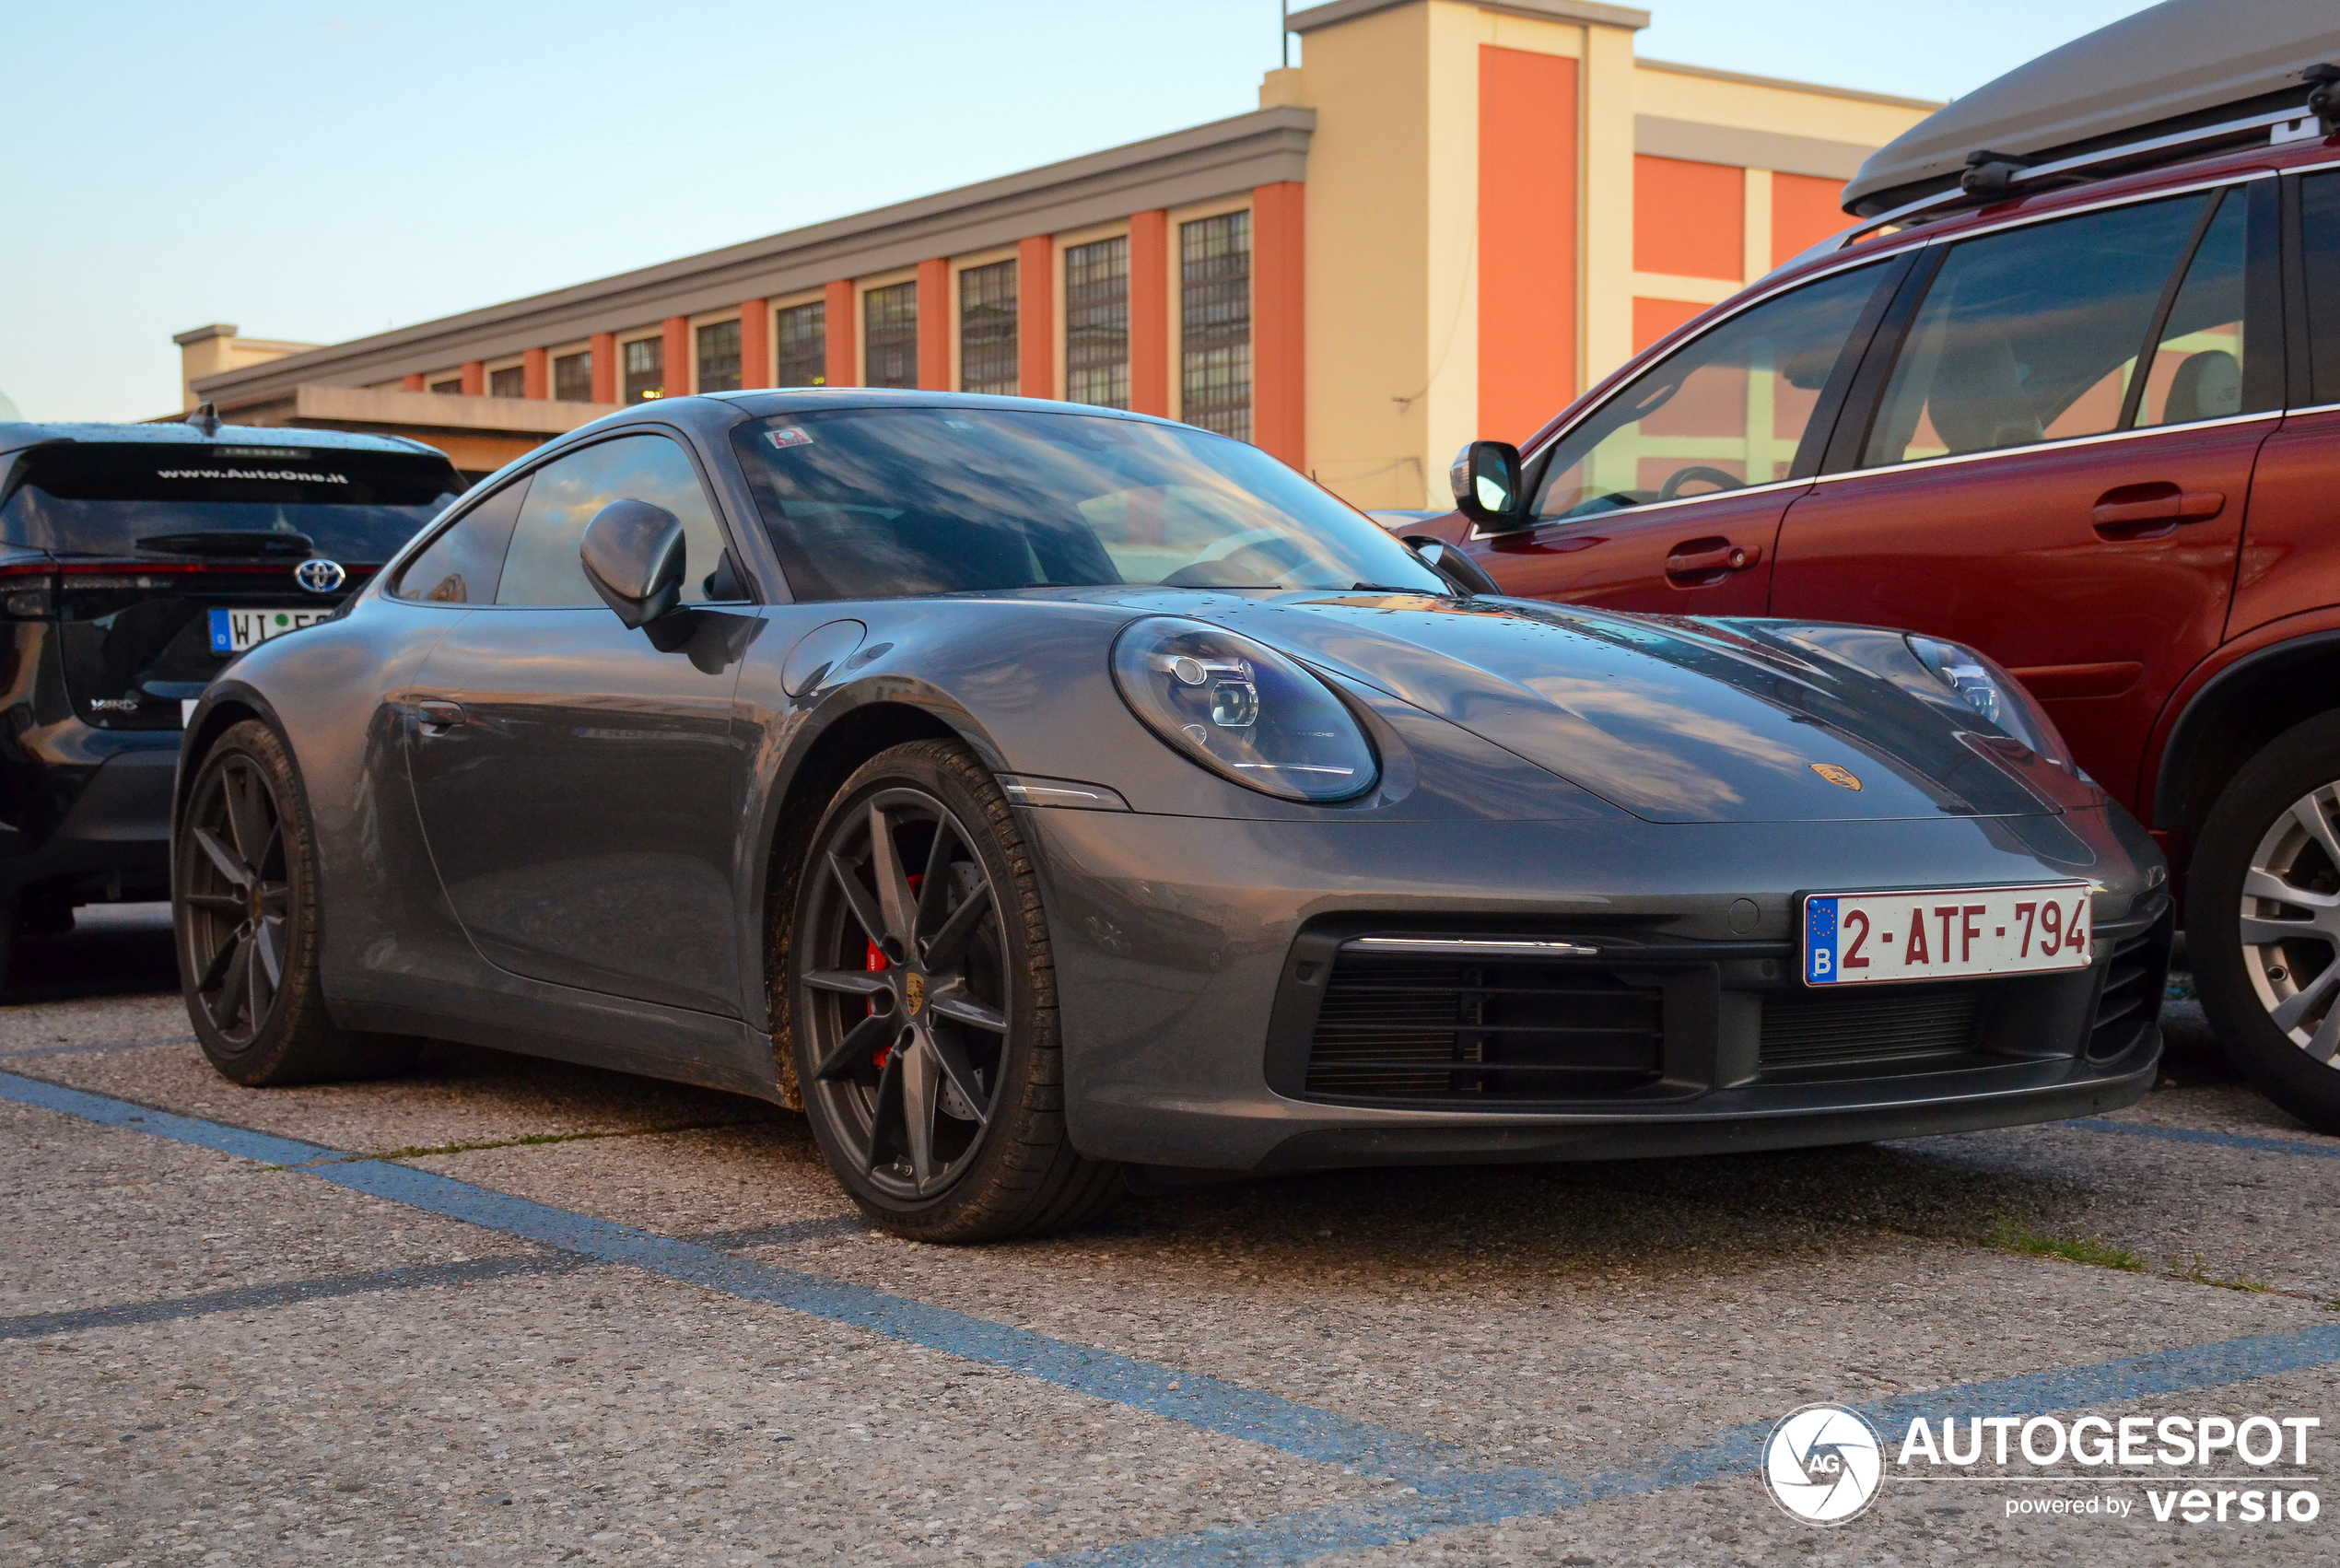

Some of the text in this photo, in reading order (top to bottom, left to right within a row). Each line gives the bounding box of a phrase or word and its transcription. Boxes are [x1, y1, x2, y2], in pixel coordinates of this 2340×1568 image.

[157, 468, 348, 484] www.AutoOne.it
[1843, 898, 2086, 968] 2-ATF-794
[1815, 949, 1831, 974] B
